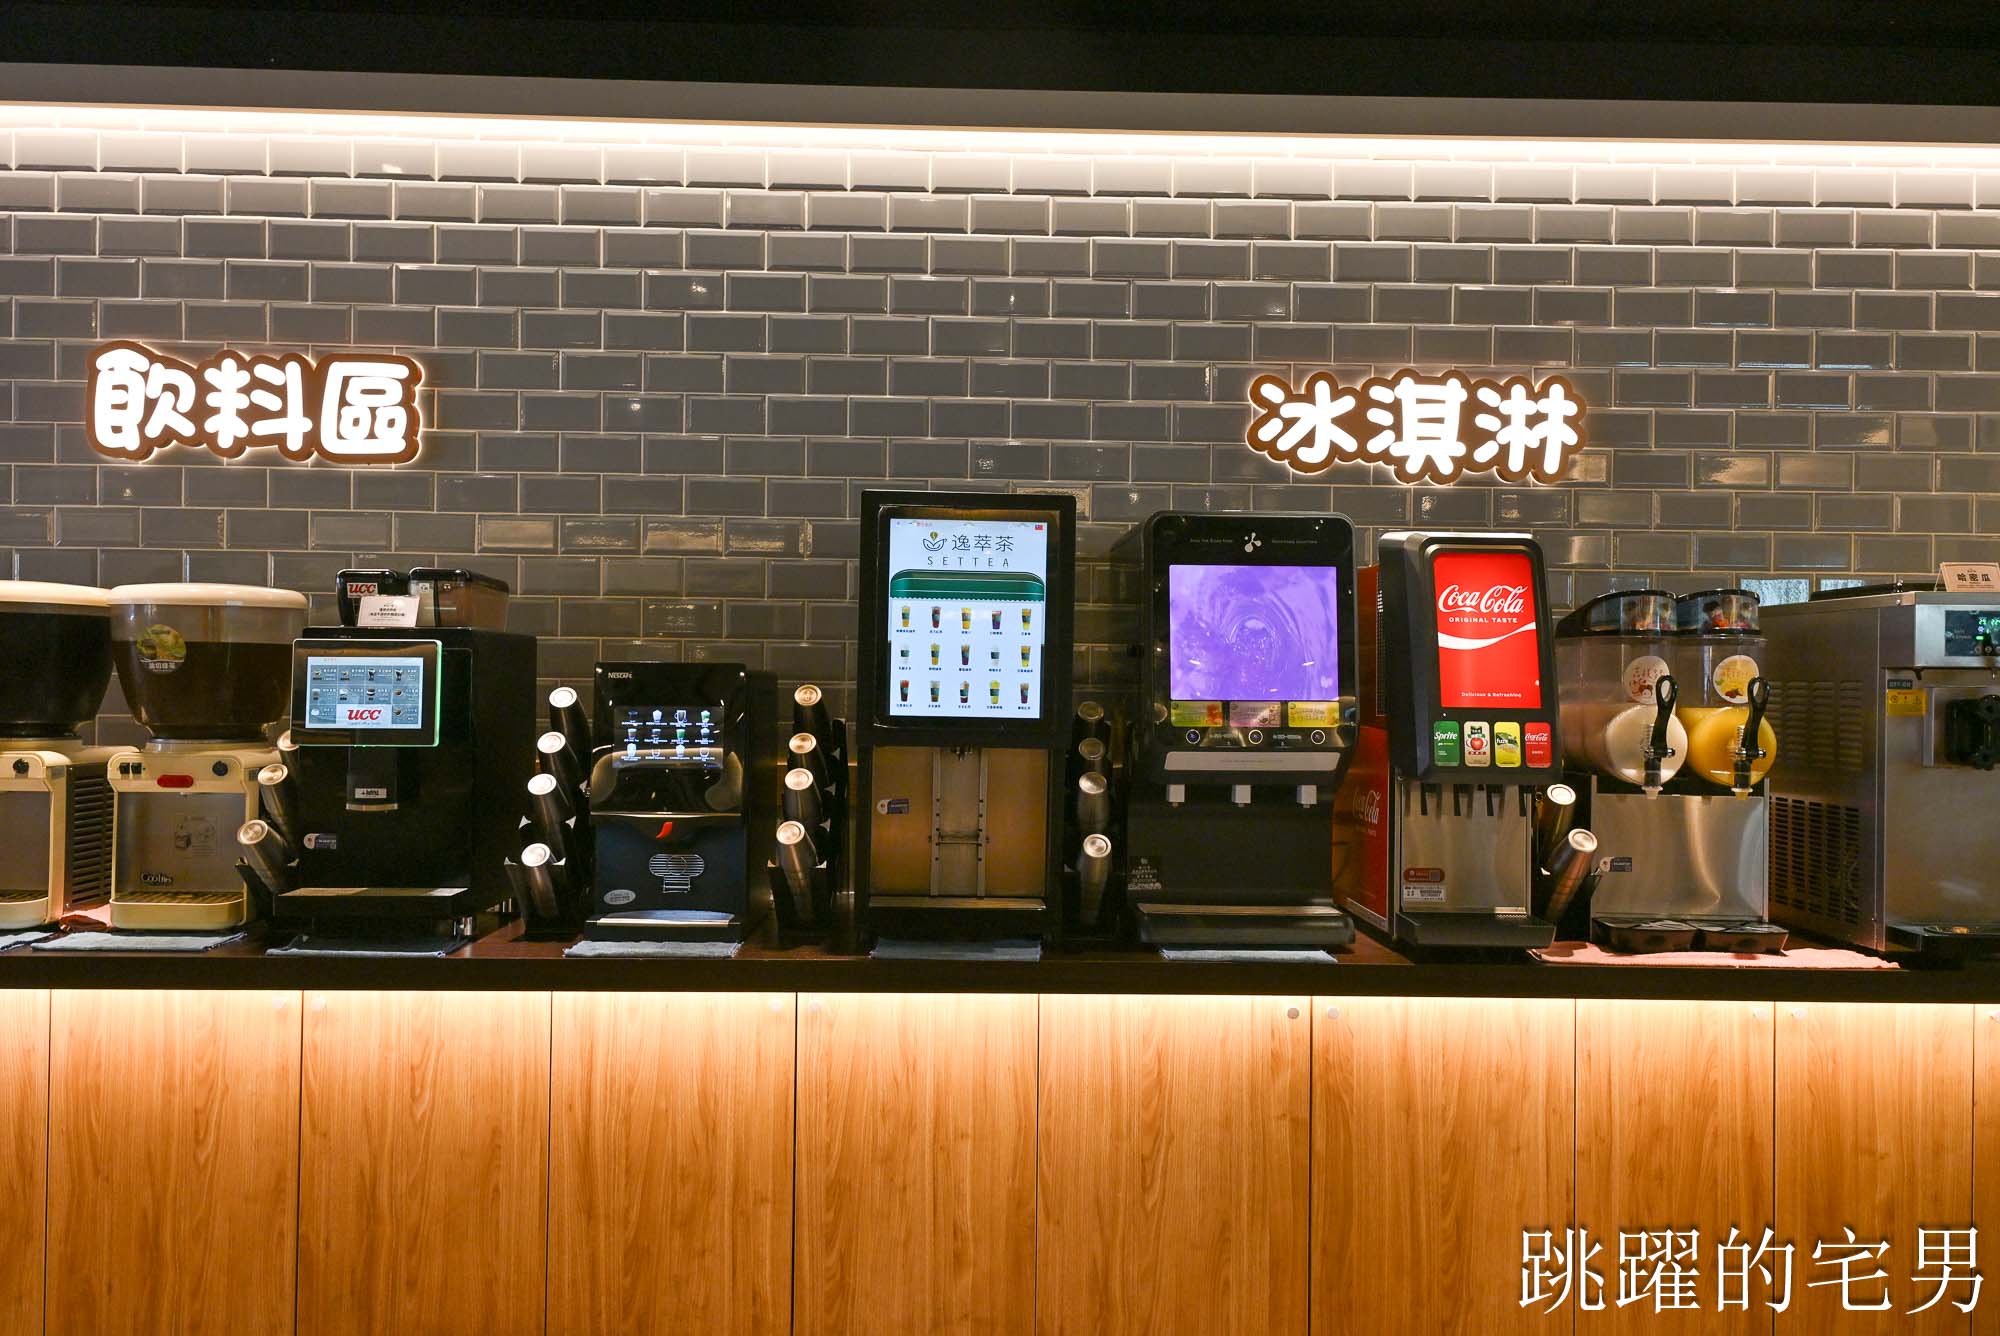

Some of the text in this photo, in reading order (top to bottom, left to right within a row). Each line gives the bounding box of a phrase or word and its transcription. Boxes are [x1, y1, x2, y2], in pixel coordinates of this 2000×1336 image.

[94, 348, 409, 455] 飲料區
[1257, 376, 1579, 475] 冰淇淋
[952, 534, 1014, 552] 逸萃茶
[927, 555, 1009, 568] SETTEA
[1957, 573, 1991, 582] 哈密瓜
[1438, 585, 1529, 613] Coca-Cola
[1434, 731, 1458, 740] Sprite
